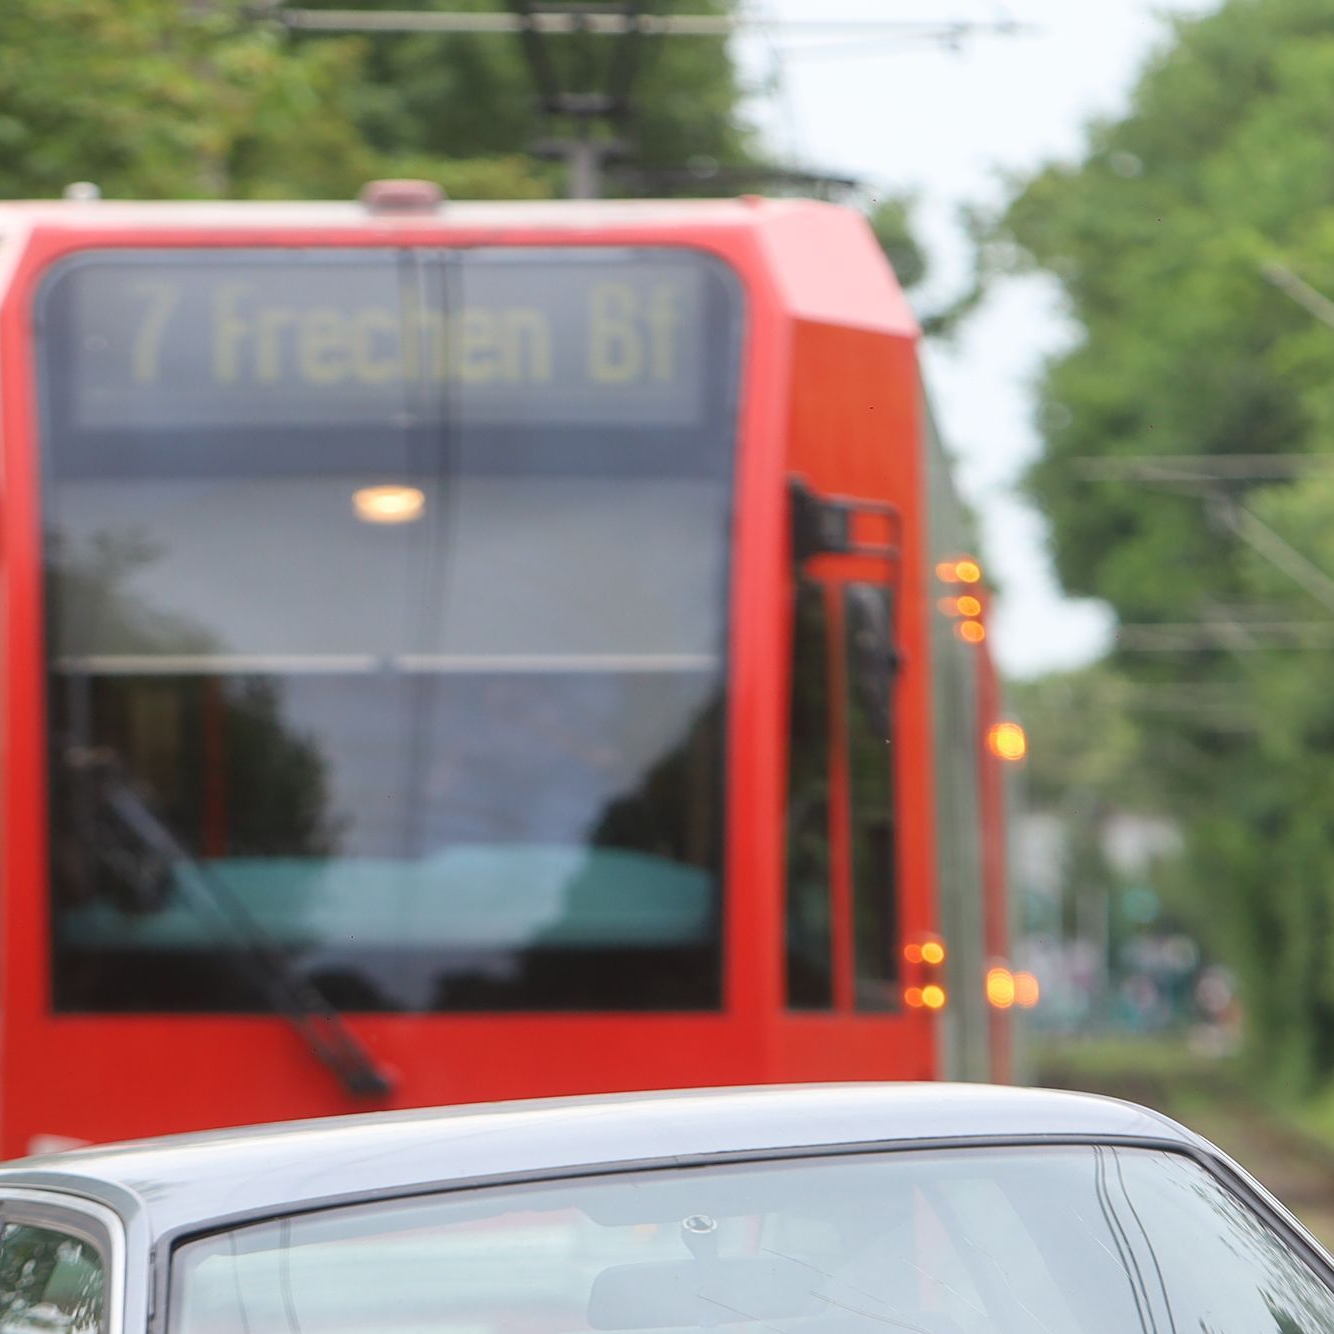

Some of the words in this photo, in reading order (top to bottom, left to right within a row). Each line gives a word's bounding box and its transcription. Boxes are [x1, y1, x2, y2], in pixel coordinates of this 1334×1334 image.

[131, 281, 181, 385] 7
[212, 281, 554, 385] Frechen
[587, 281, 683, 385] Bf
